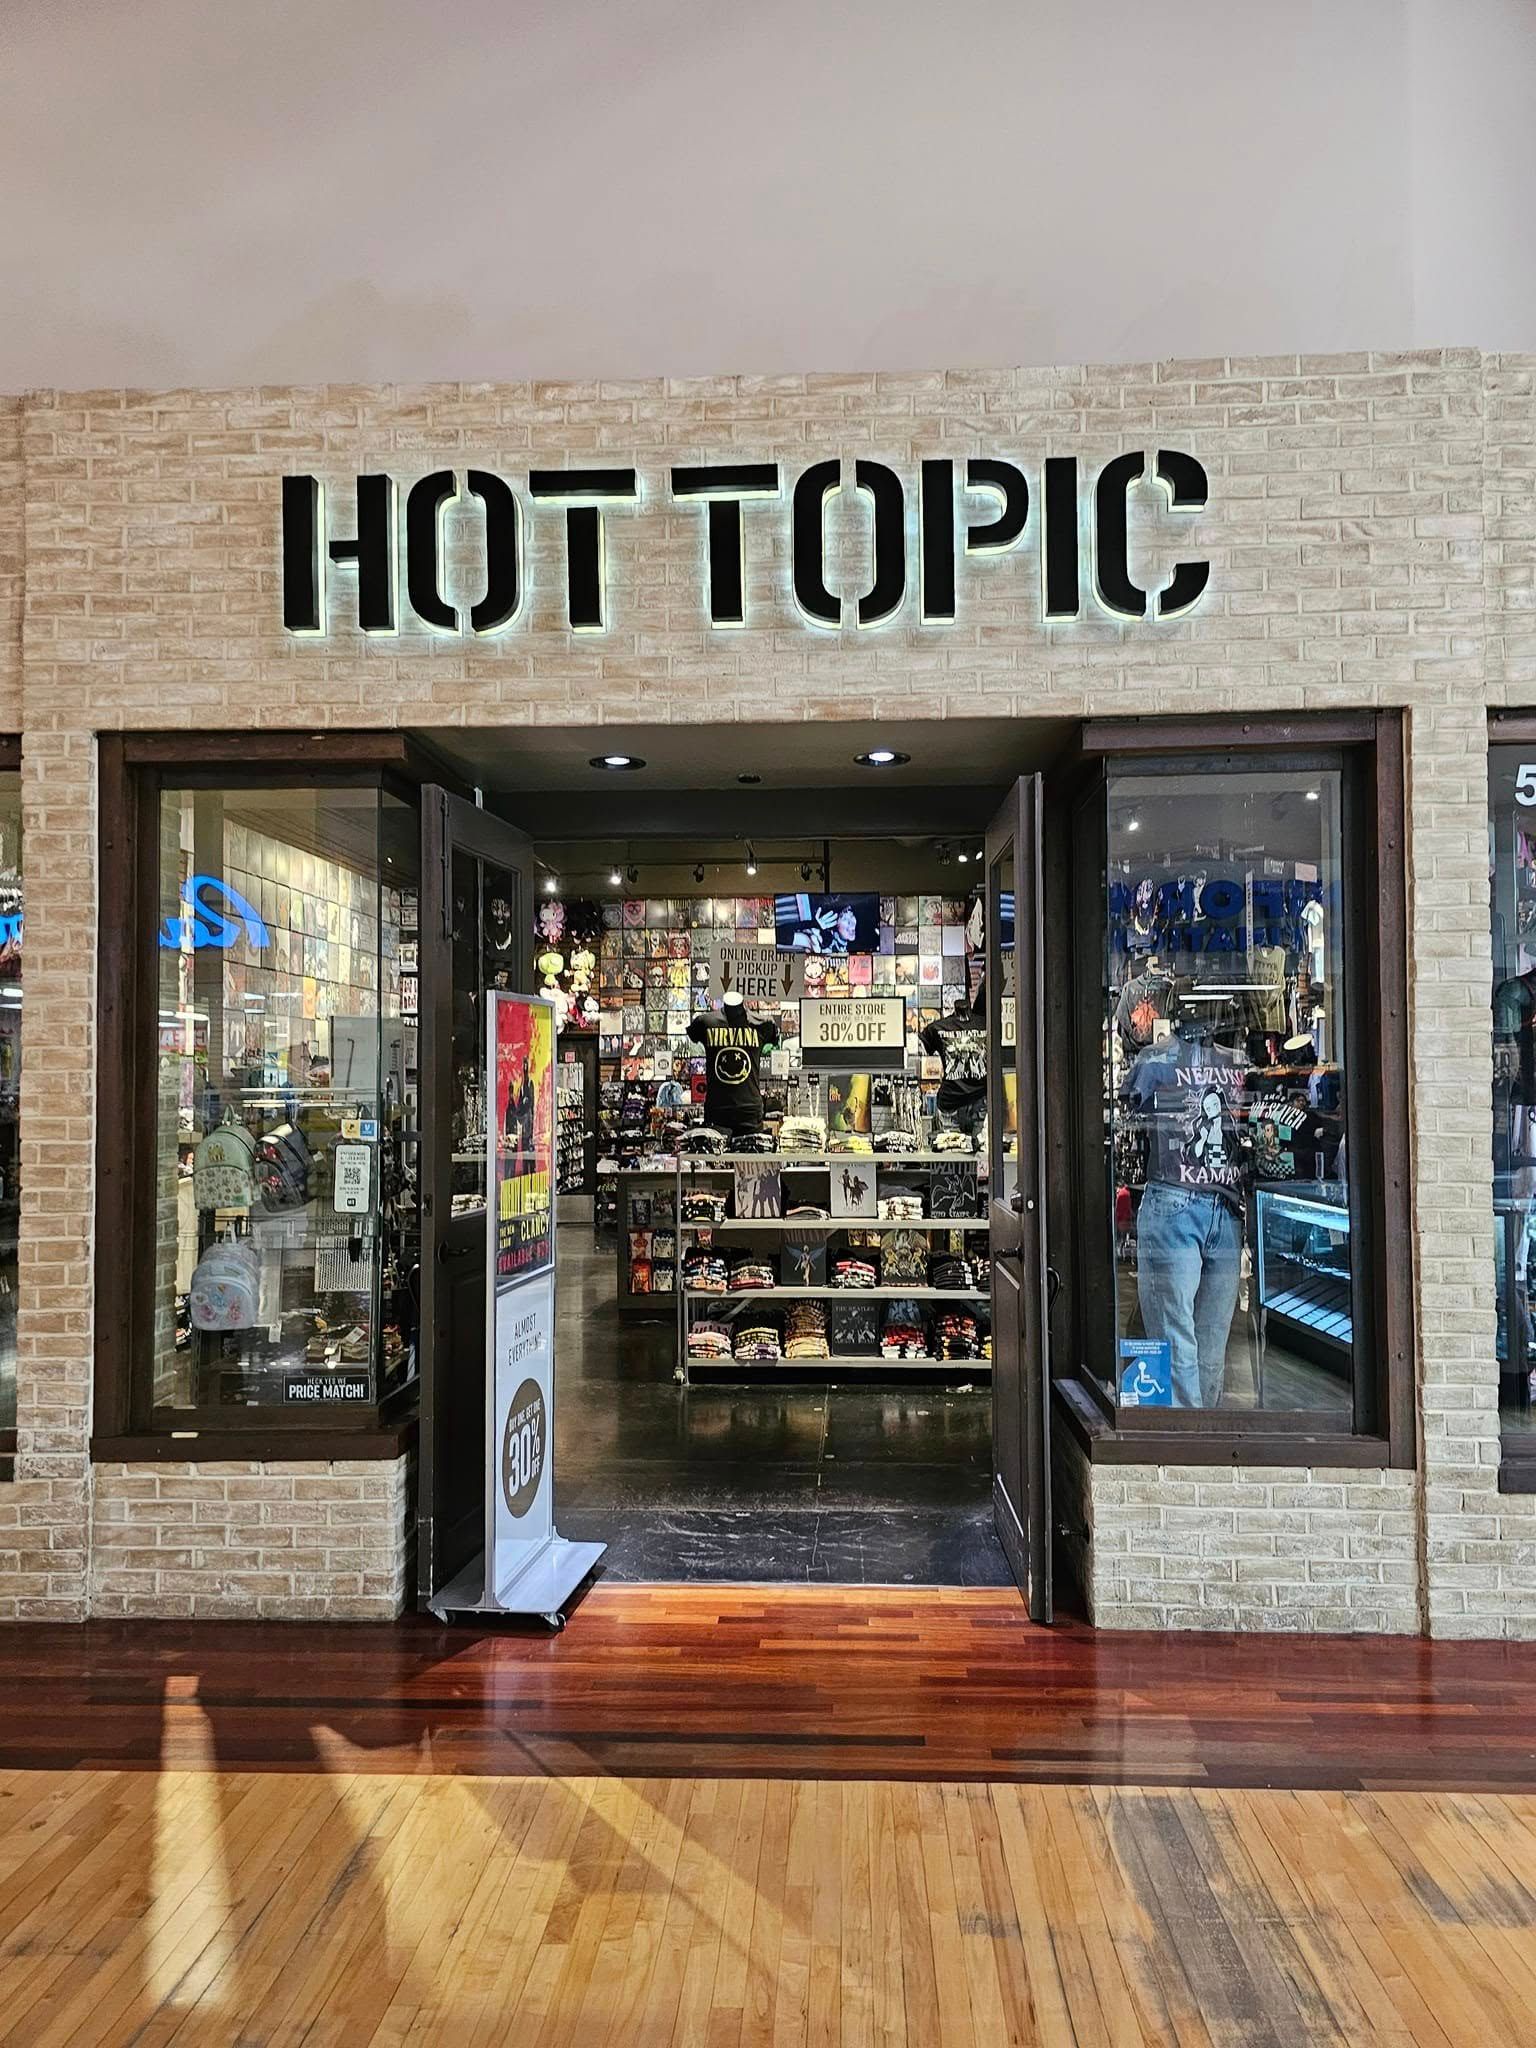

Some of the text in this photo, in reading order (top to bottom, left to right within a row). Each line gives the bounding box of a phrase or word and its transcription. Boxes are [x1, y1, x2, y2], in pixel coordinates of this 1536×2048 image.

[282, 450, 1211, 634] HOT TOPIC
[720, 947, 796, 963] ONLINE ORDER
[737, 962, 778, 976] PICKUP
[735, 977, 777, 997] HERE
[819, 1003, 887, 1015] ENTIRE STORE
[706, 1027, 760, 1048] NIRVANA
[819, 1022, 887, 1042] 30% OFF
[521, 1213, 549, 1241] CLANCY
[514, 1312, 536, 1340] ALMOST
[288, 1383, 364, 1399] PRICE MATCH!
[508, 1414, 541, 1497] 30%
[531, 1455, 541, 1478] OFF
